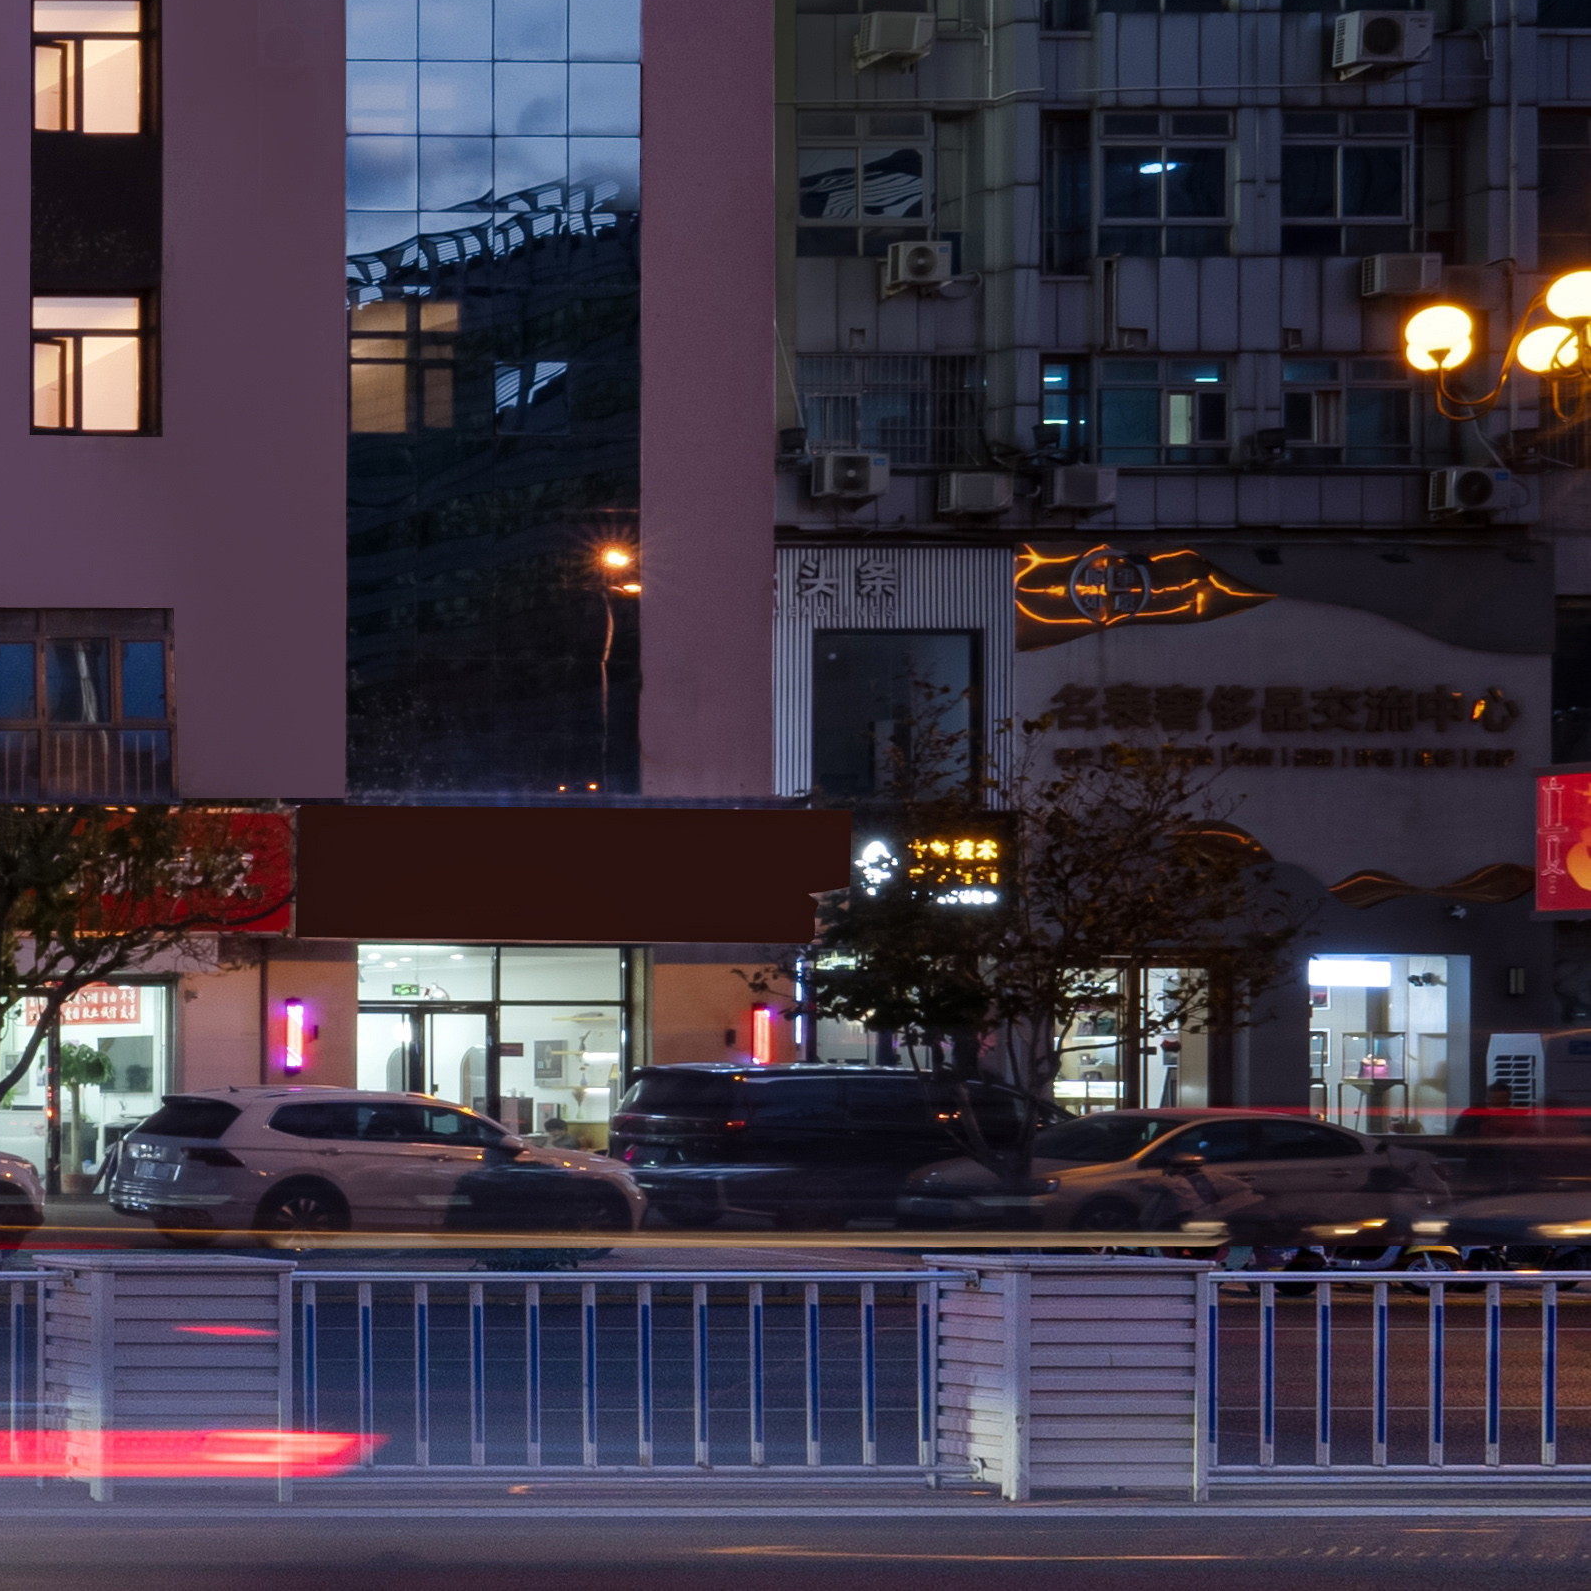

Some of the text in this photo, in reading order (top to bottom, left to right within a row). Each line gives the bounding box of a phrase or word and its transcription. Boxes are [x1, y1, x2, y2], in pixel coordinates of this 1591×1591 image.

[798, 557, 896, 597] 头条
[1051, 682, 1521, 733] 名表奢侈品交流中心
